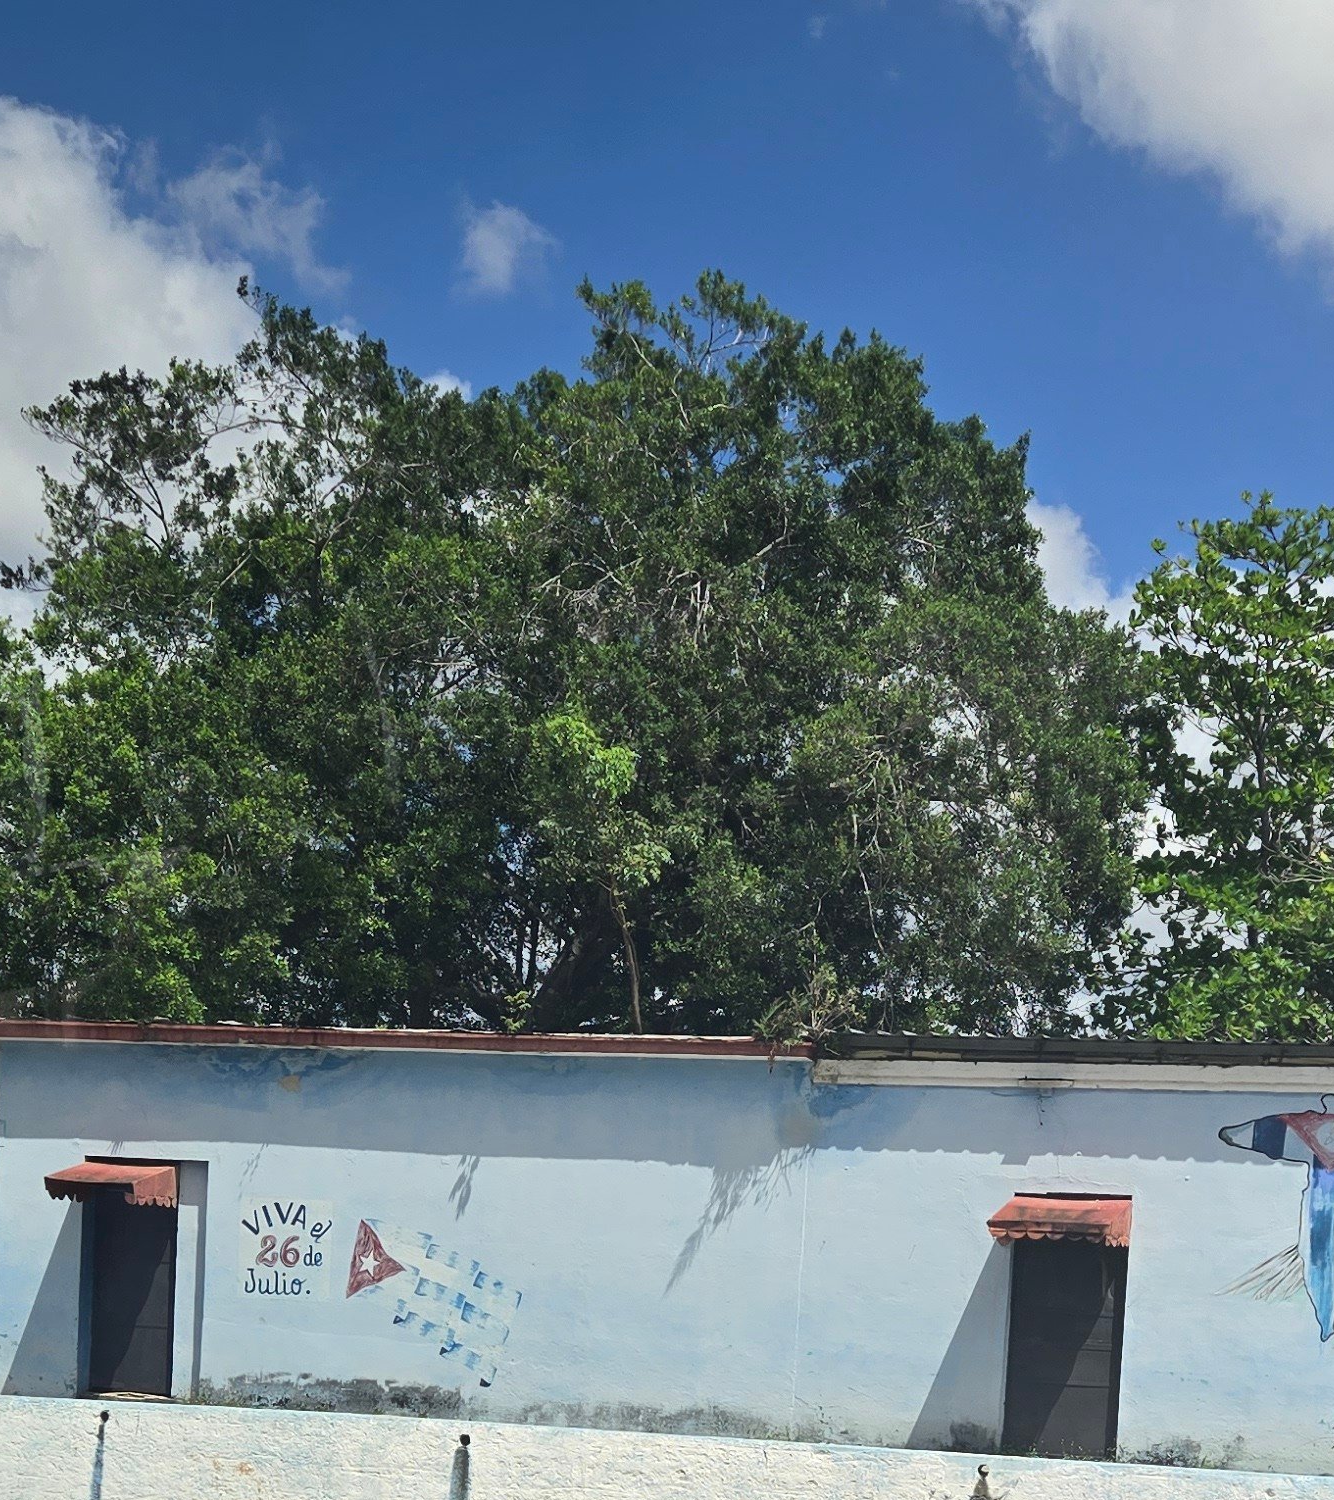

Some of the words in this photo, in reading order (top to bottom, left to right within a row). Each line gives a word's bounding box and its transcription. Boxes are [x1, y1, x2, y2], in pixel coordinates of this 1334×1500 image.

[241, 1202, 306, 1235] VIVA
[310, 1220, 332, 1243] el
[256, 1234, 300, 1267] 26
[304, 1245, 323, 1266] de
[244, 1268, 311, 1295] Julio.
